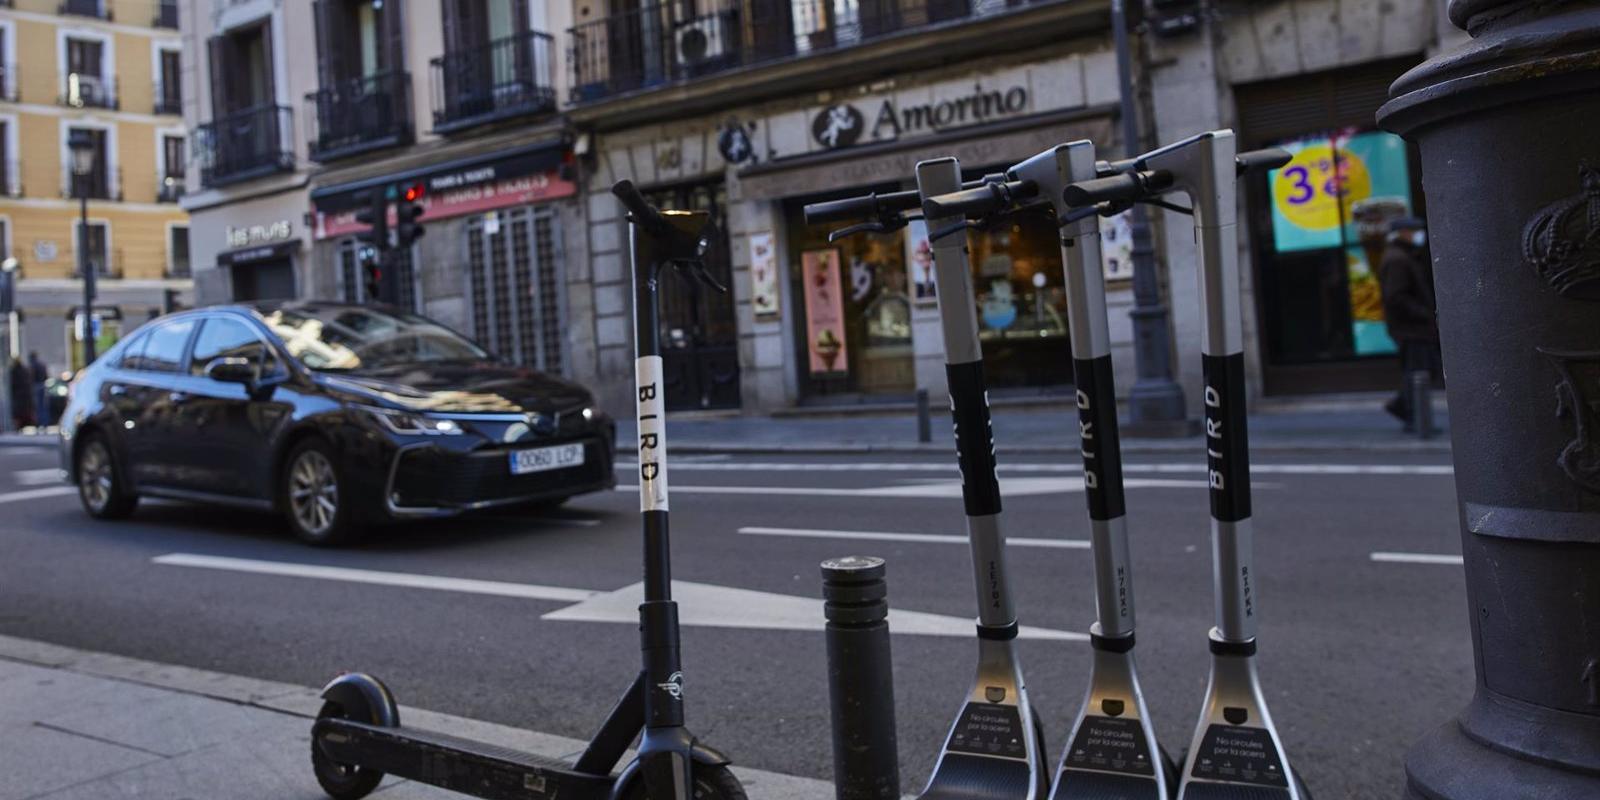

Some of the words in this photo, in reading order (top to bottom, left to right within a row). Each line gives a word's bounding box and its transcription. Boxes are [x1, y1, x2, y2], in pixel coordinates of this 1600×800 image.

[872, 82, 1026, 138] Amorino
[639, 382, 659, 482] BIRD
[1205, 385, 1225, 490] BIRD
